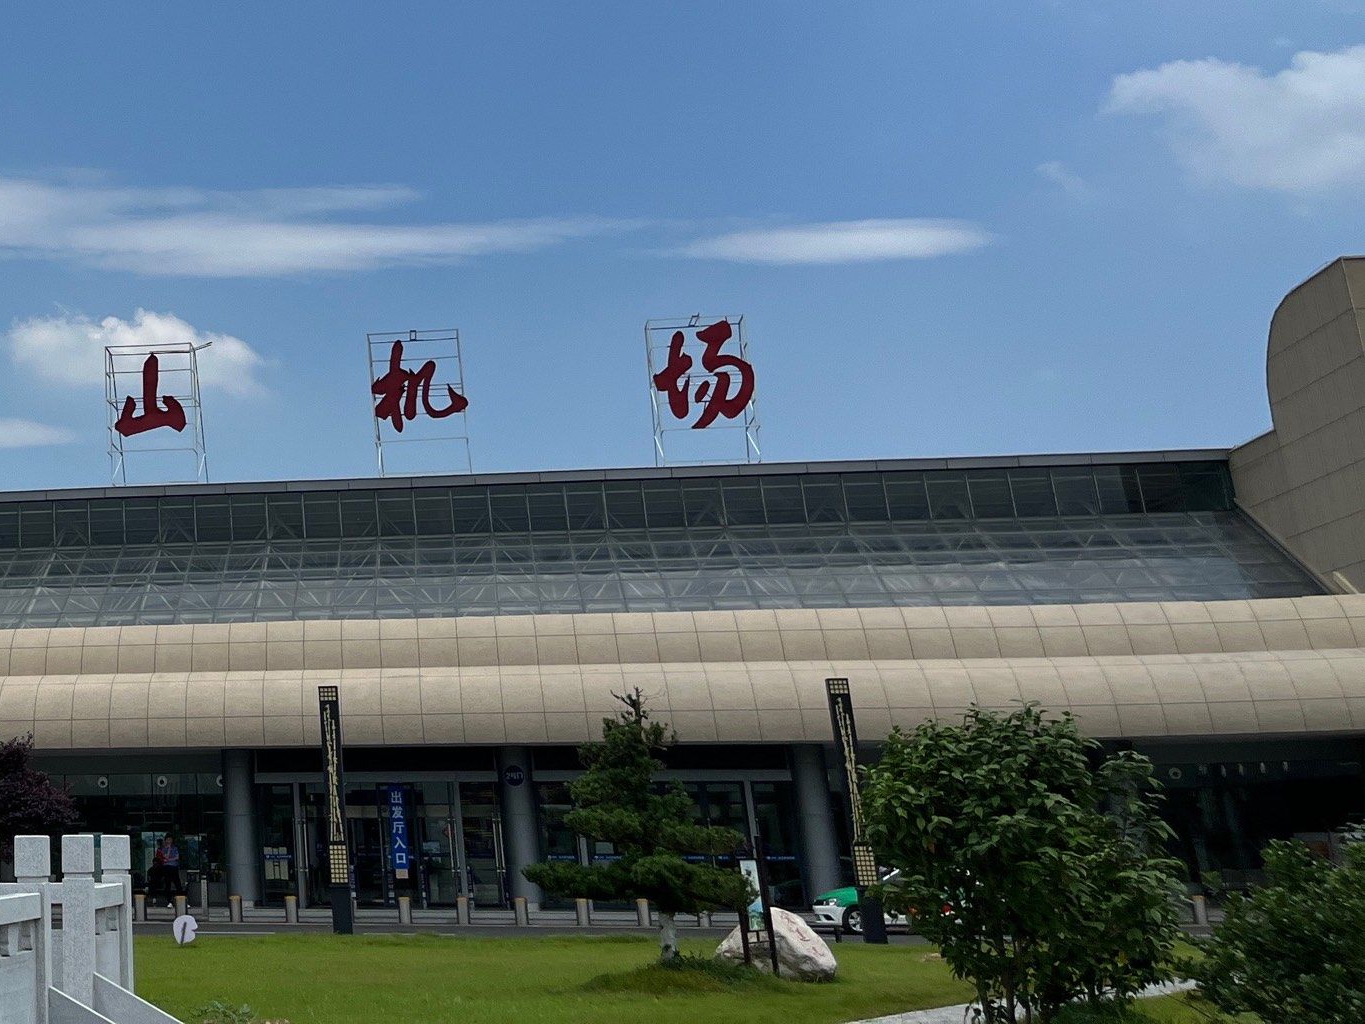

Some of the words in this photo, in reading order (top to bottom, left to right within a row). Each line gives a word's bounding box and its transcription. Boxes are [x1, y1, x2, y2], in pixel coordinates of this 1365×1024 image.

[390, 790, 407, 864] 出发厅入口
